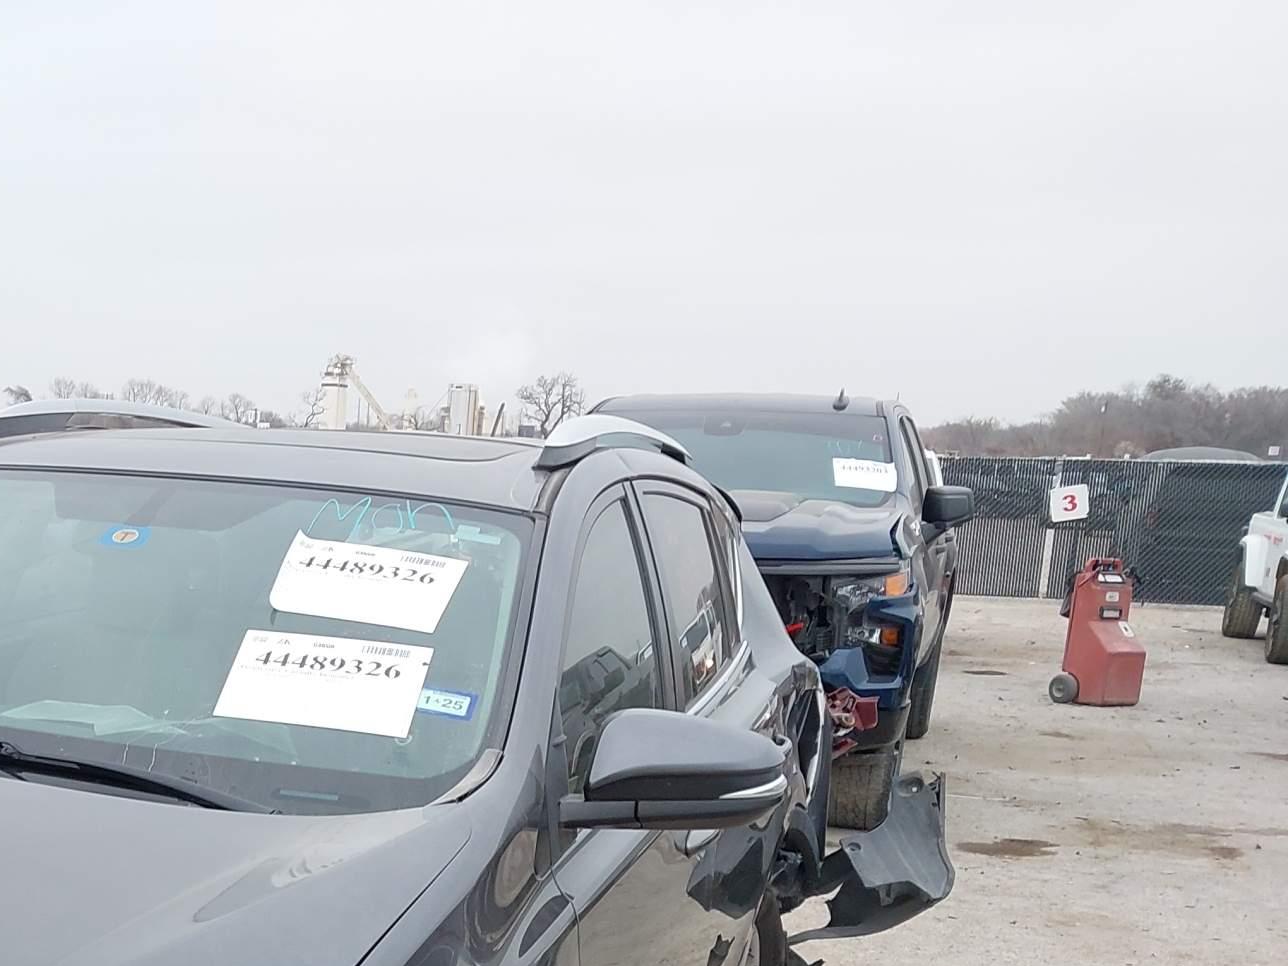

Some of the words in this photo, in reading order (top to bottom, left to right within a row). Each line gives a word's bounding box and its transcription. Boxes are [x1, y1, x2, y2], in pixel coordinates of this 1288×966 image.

[1062, 494, 1078, 512] 3
[299, 556, 435, 585] 44489326
[255, 651, 402, 680] 44489326
